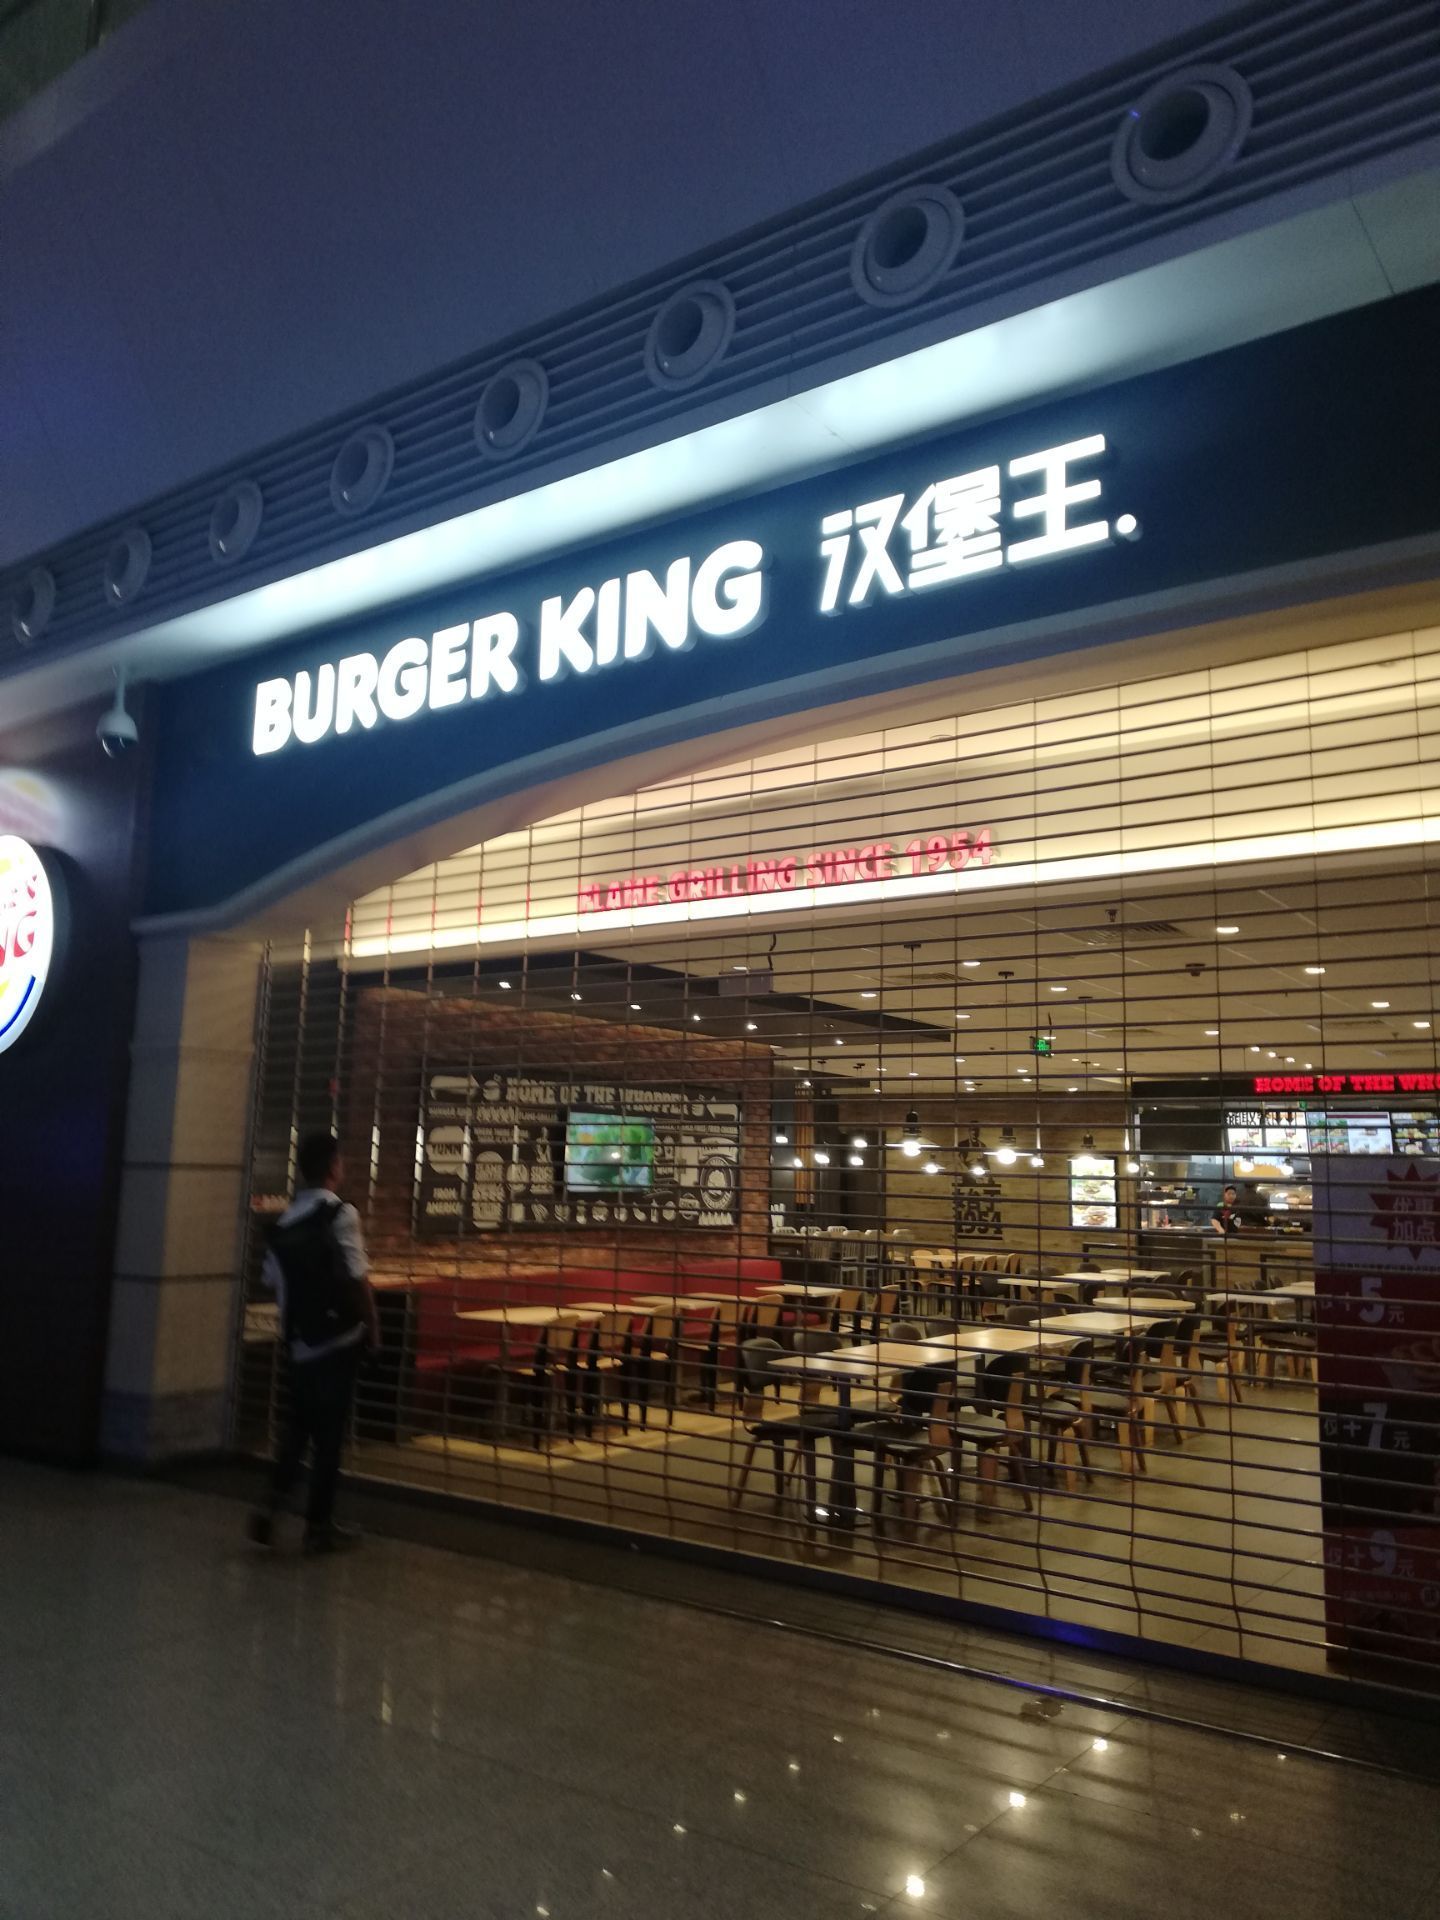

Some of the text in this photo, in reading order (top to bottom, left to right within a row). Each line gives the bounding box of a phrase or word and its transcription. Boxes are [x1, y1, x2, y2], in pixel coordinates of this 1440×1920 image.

[252, 540, 763, 756] BURGER KING
[578, 829, 993, 914] FLAME GRILLING SINCE 1954
[583, 1085, 615, 1108] THE
[1255, 1076, 1314, 1093] HOME
[1318, 1075, 1346, 1092] OF
[1350, 1075, 1395, 1092] THE
